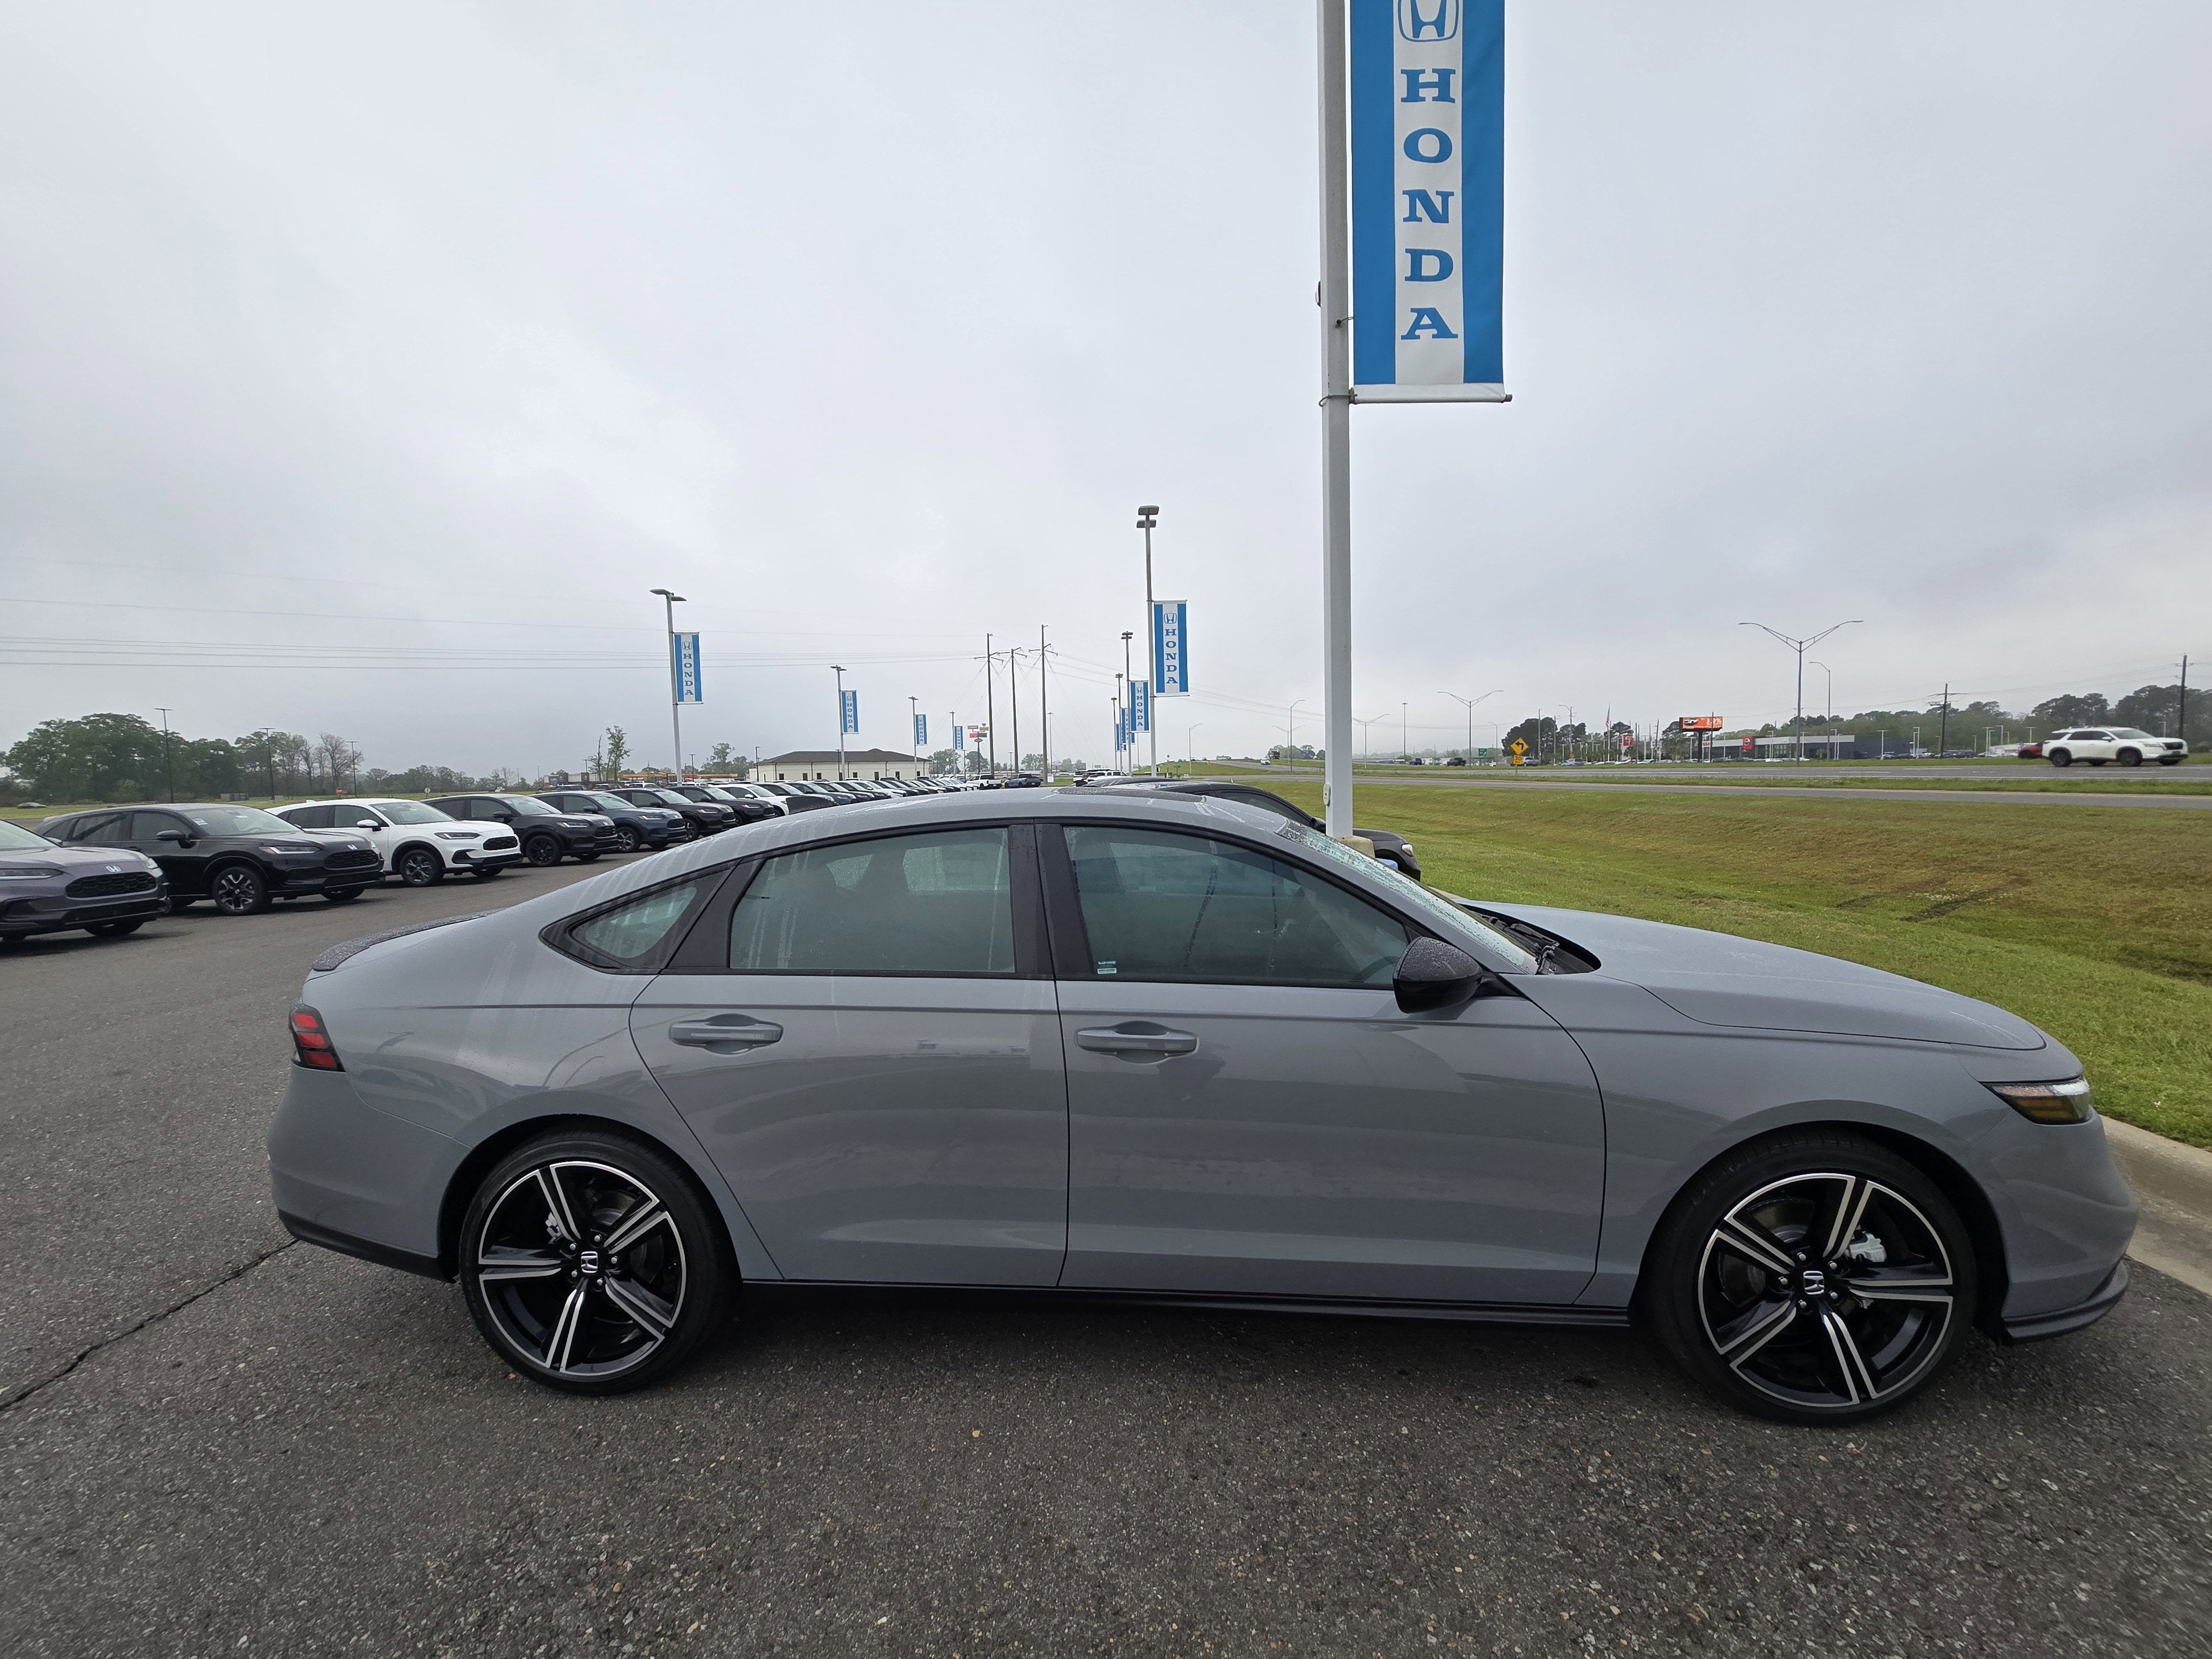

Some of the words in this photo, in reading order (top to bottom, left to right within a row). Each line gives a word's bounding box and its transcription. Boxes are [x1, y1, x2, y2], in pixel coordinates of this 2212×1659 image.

[1400, 68, 1458, 340] HONDA
[683, 654, 693, 695] HONDA
[1165, 629, 1178, 684] HONDA
